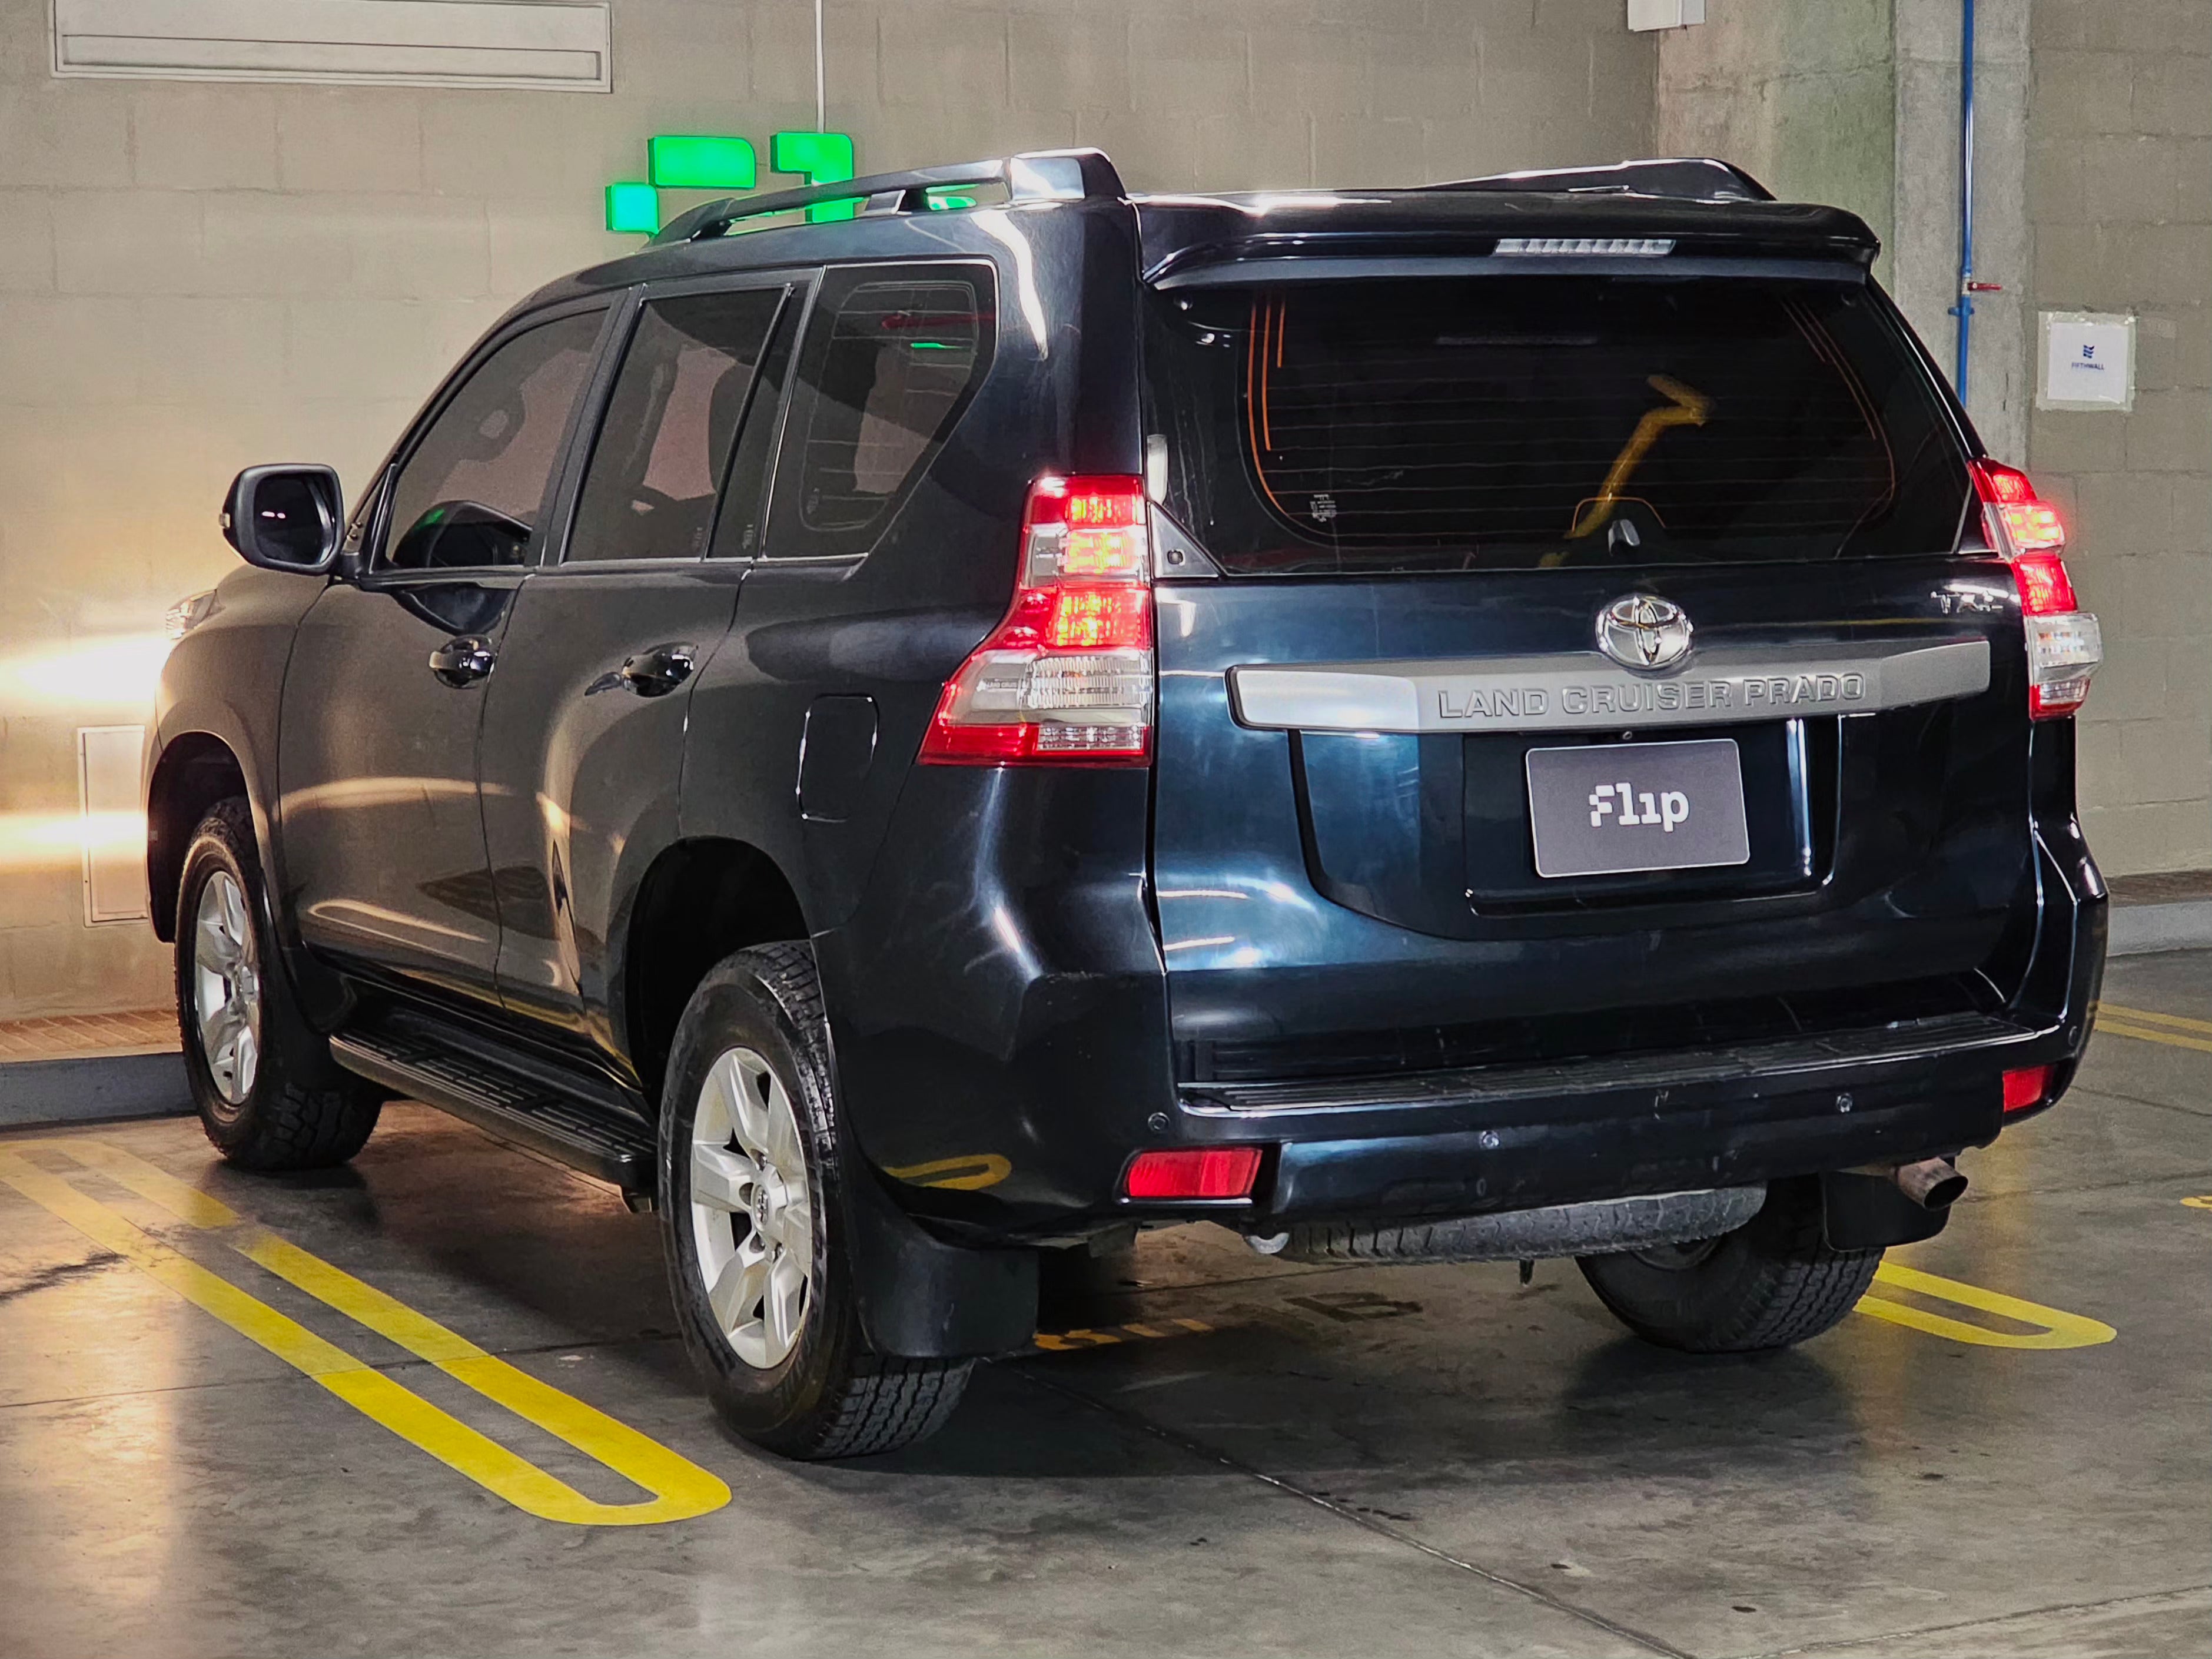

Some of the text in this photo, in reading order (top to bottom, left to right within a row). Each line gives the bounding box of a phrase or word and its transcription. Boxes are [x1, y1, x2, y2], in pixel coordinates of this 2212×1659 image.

[1437, 672, 1866, 718] LAND CRUISER PRADO
[1589, 782, 1689, 832] Flip
